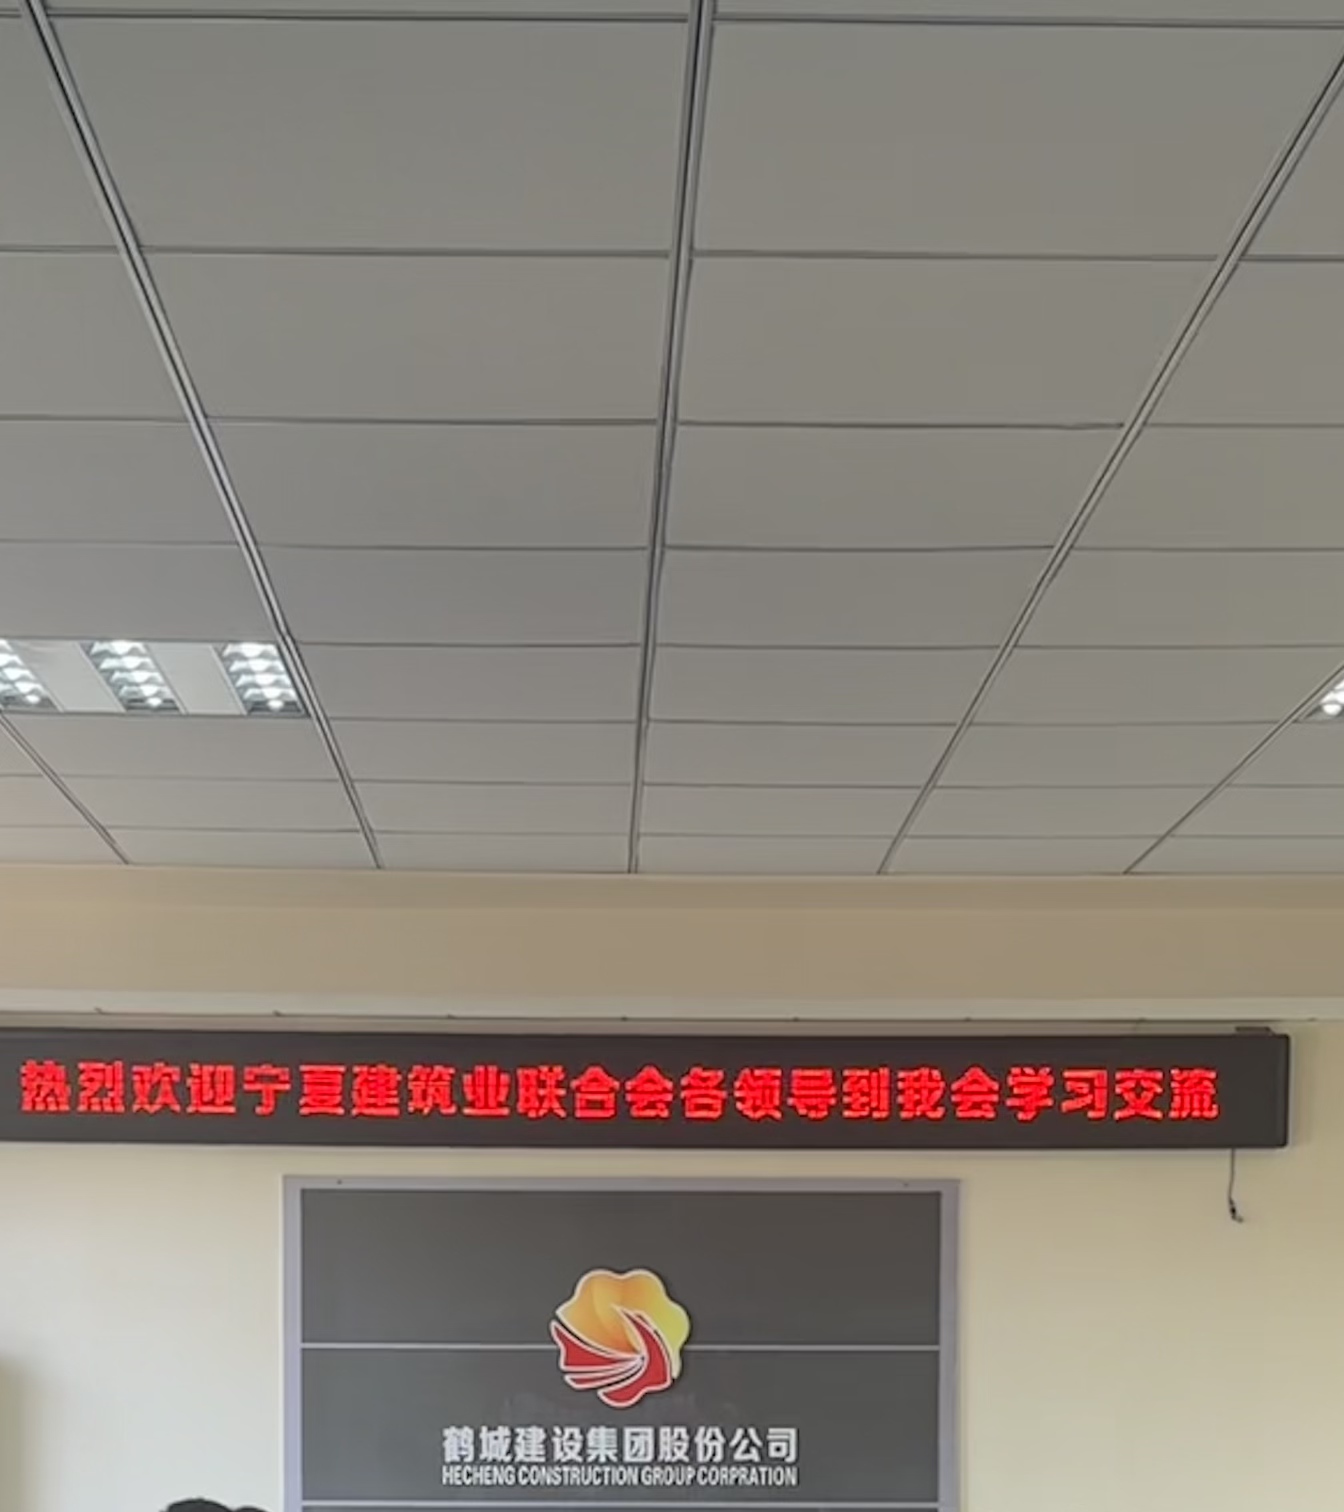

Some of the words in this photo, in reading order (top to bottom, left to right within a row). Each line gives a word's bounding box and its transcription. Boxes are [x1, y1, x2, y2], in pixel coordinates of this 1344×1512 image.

[20, 1059, 1220, 1123] 热烈欢迎宁夏建筑业联合会各领导到我会学习交流
[442, 1425, 797, 1463] 鹤城建设集团股份公司
[441, 1464, 516, 1486] HECHENG
[517, 1464, 639, 1486] CONSTRUCTION
[640, 1464, 696, 1486] GROUP
[696, 1464, 797, 1486] CORPRATION
